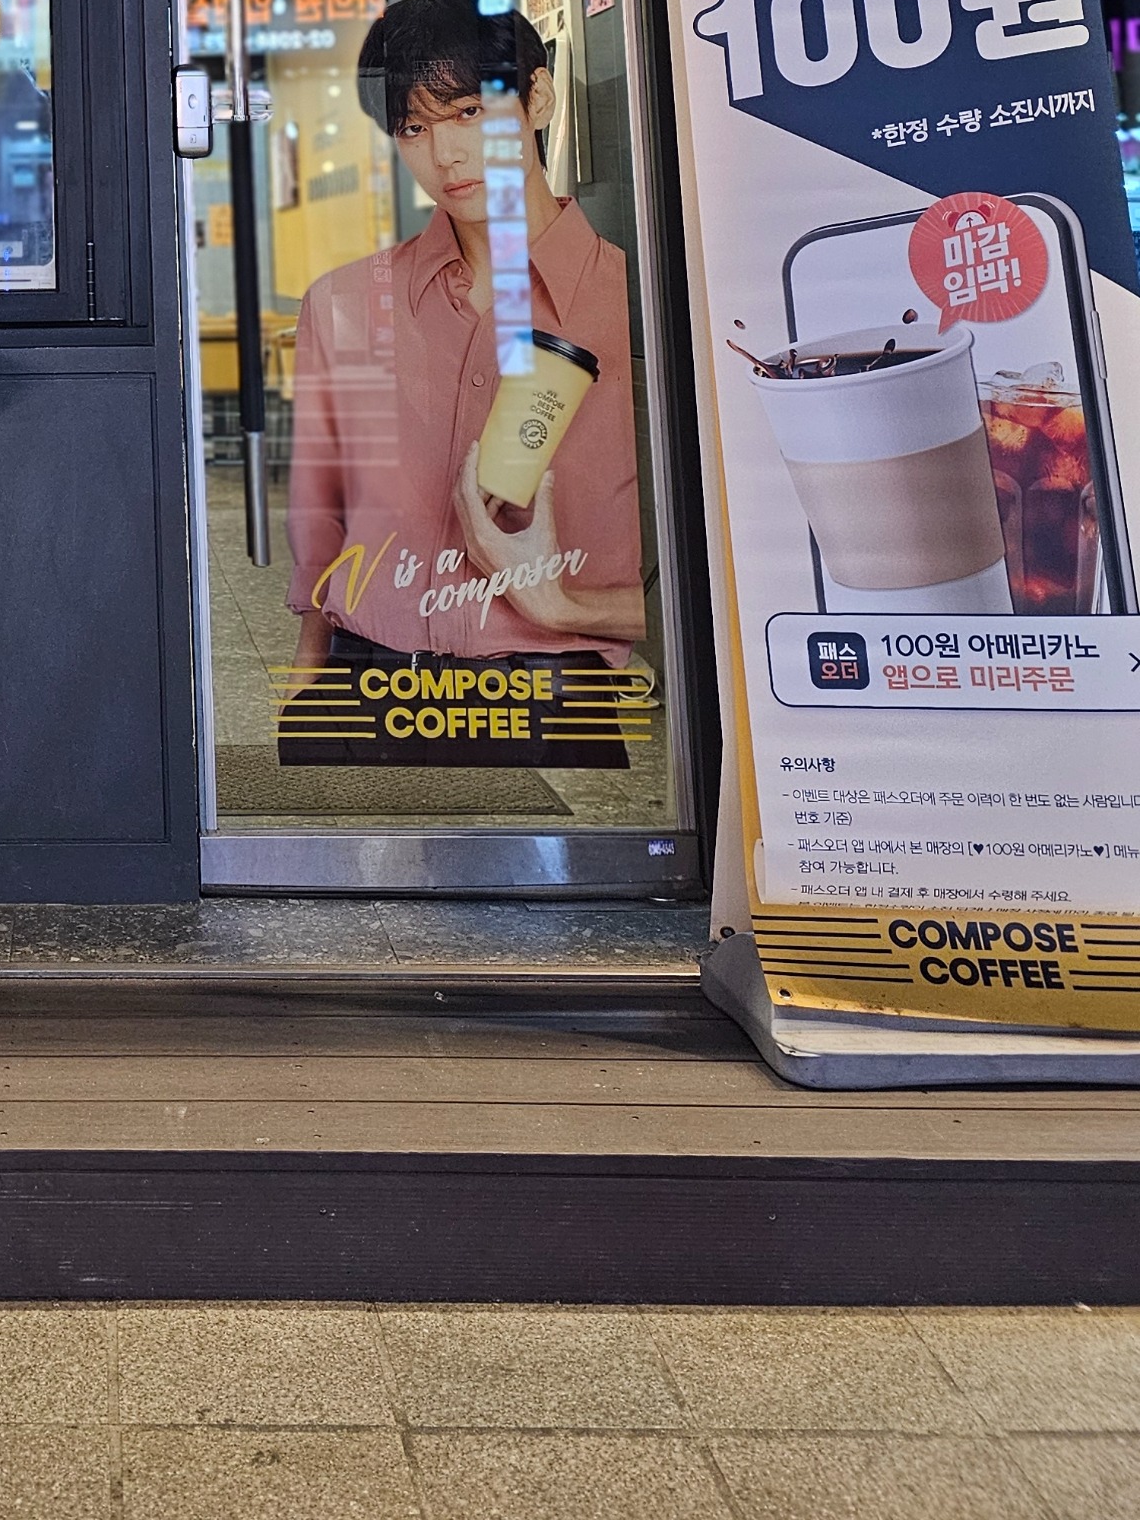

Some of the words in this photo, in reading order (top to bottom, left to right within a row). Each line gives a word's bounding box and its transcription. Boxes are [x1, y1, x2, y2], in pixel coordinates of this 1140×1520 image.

[935, 108, 982, 136] 수량
[988, 88, 1096, 130] 소진시까지
[942, 222, 1012, 269] 마감
[942, 257, 1023, 308] 임박!
[393, 548, 424, 589] is
[436, 547, 465, 575] a
[418, 547, 589, 630] composer
[817, 641, 858, 661] 패스
[880, 633, 961, 660] 100원
[967, 633, 1101, 661] 아메리카노
[359, 668, 554, 701] COMPOSE
[820, 661, 859, 681] 오더
[882, 664, 962, 691] 앱으로
[969, 664, 1075, 693] 미리주문
[384, 706, 531, 740] COFFEE
[779, 756, 836, 773] 유의사항
[792, 788, 831, 803] 이벤트
[832, 789, 871, 804] 대상은
[873, 790, 937, 806] 패스오더에
[938, 791, 965, 807] 주문
[967, 792, 1006, 807] 이력이
[1009, 792, 1022, 807] 한
[1025, 793, 1052, 808] 번도
[1053, 793, 1080, 808] 없는
[794, 810, 821, 825] 번호
[823, 811, 853, 827] 기준)
[797, 837, 849, 854] 패스오더
[851, 838, 866, 854] 앱
[868, 840, 907, 855] 내에서
[909, 840, 923, 855] 본
[926, 840, 965, 856] 매장의
[798, 859, 825, 874] 참여
[830, 860, 899, 875] 가능합니다.
[800, 883, 851, 897] 패스오더
[854, 885, 868, 898] 앱
[871, 885, 884, 898] 내
[887, 886, 914, 899] 결제
[916, 887, 930, 899] 후
[933, 887, 985, 900] 매장에서
[887, 918, 1080, 953] COMPOSE
[918, 955, 1066, 990] COFFEE
